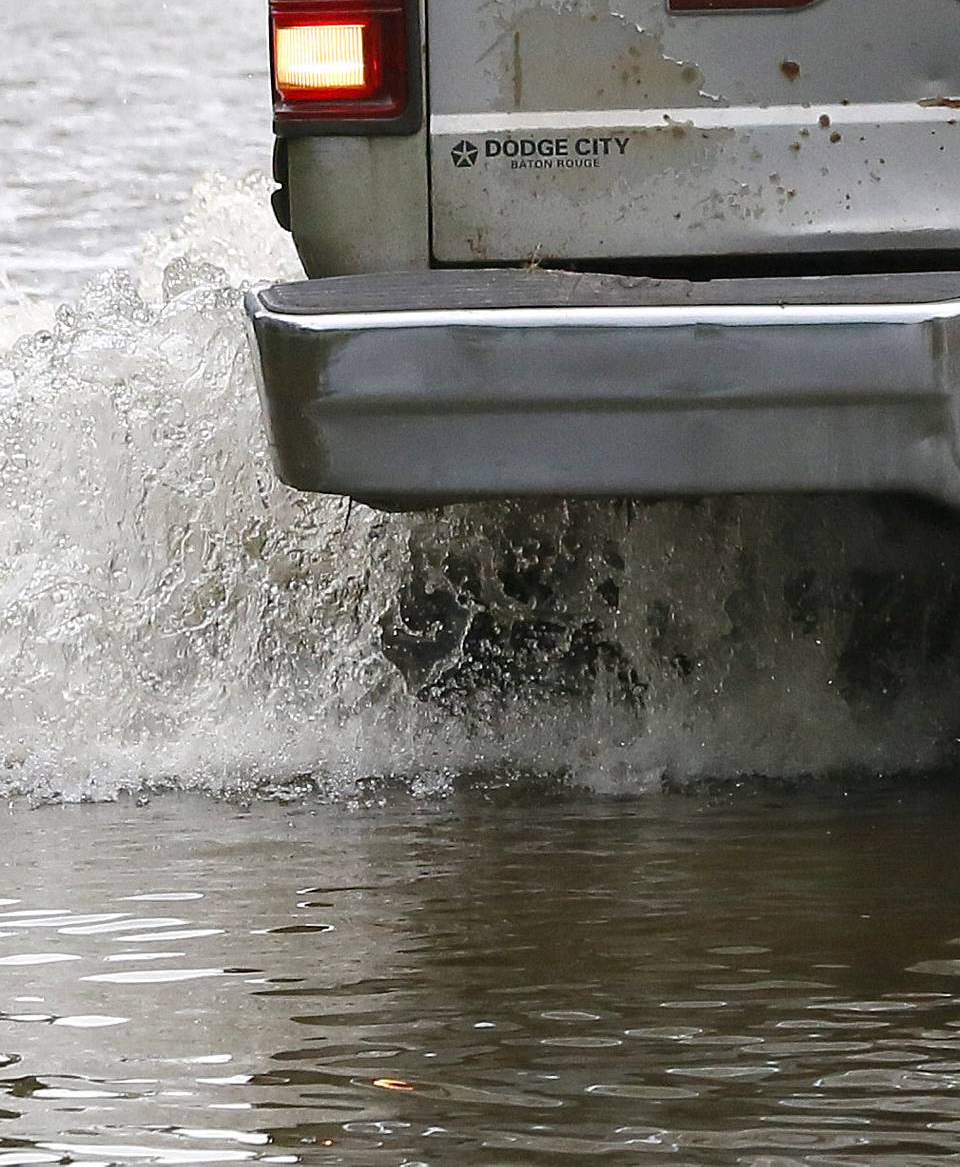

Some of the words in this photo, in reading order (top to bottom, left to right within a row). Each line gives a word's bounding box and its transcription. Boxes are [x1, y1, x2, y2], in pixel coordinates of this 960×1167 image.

[485, 138, 569, 158] DODGE
[574, 137, 630, 155] CITY
[511, 159, 553, 170] BATON
[557, 159, 600, 169] ROUGE
